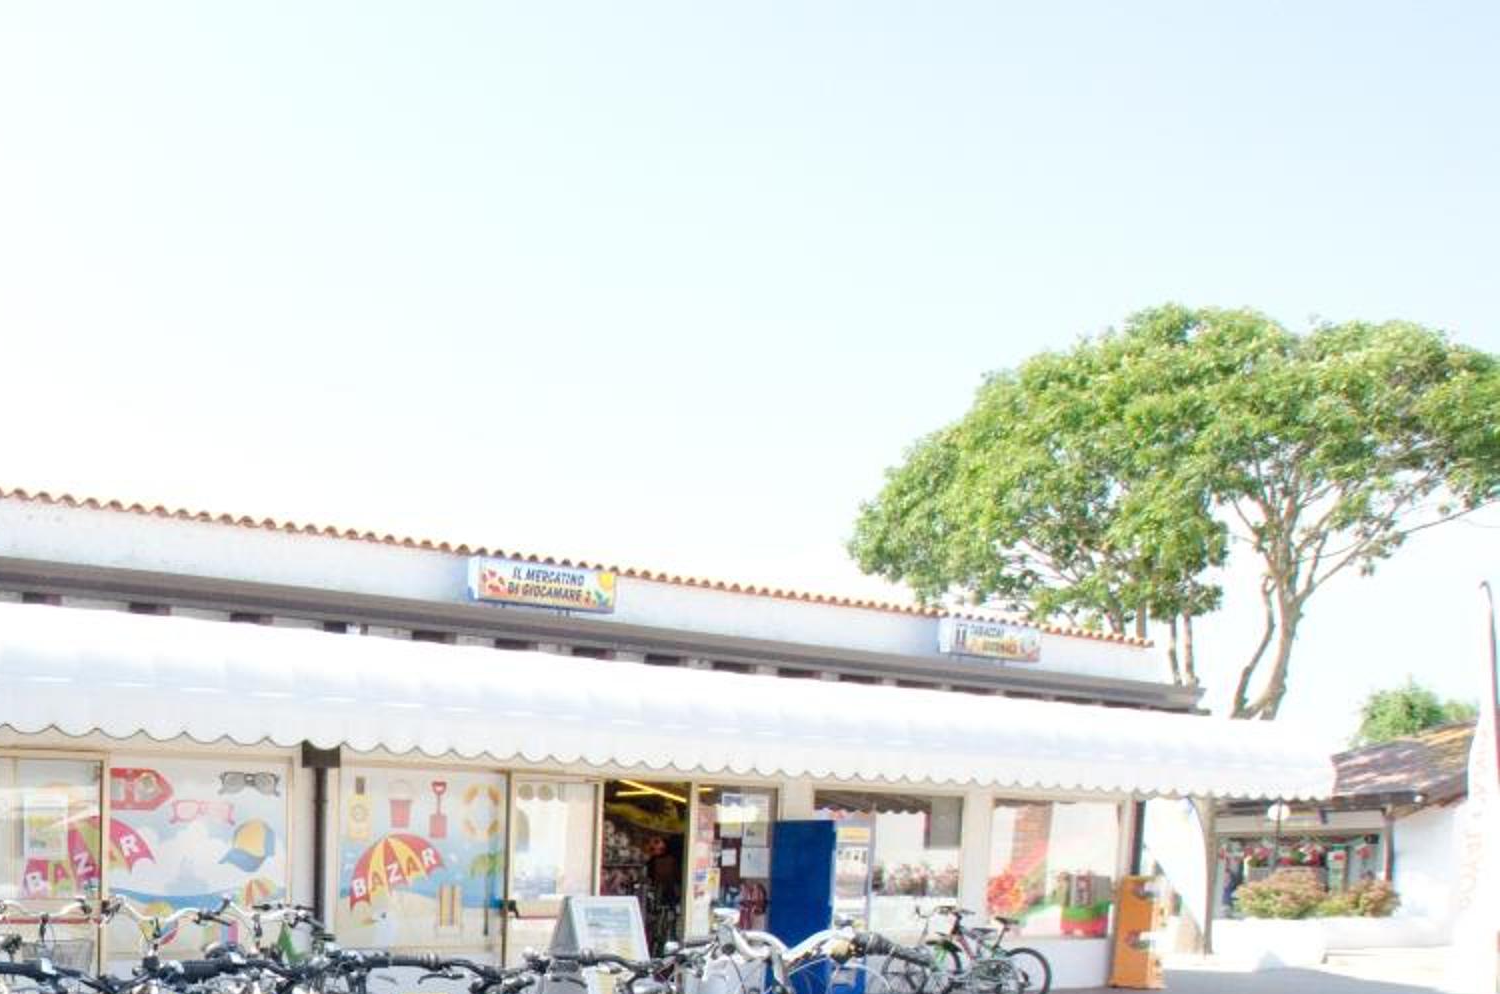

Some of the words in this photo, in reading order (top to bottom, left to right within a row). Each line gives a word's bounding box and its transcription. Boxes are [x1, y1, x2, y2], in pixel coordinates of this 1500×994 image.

[513, 566, 521, 580] IL
[526, 568, 585, 586] MERCATINO
[352, 847, 438, 899] BAZAR
